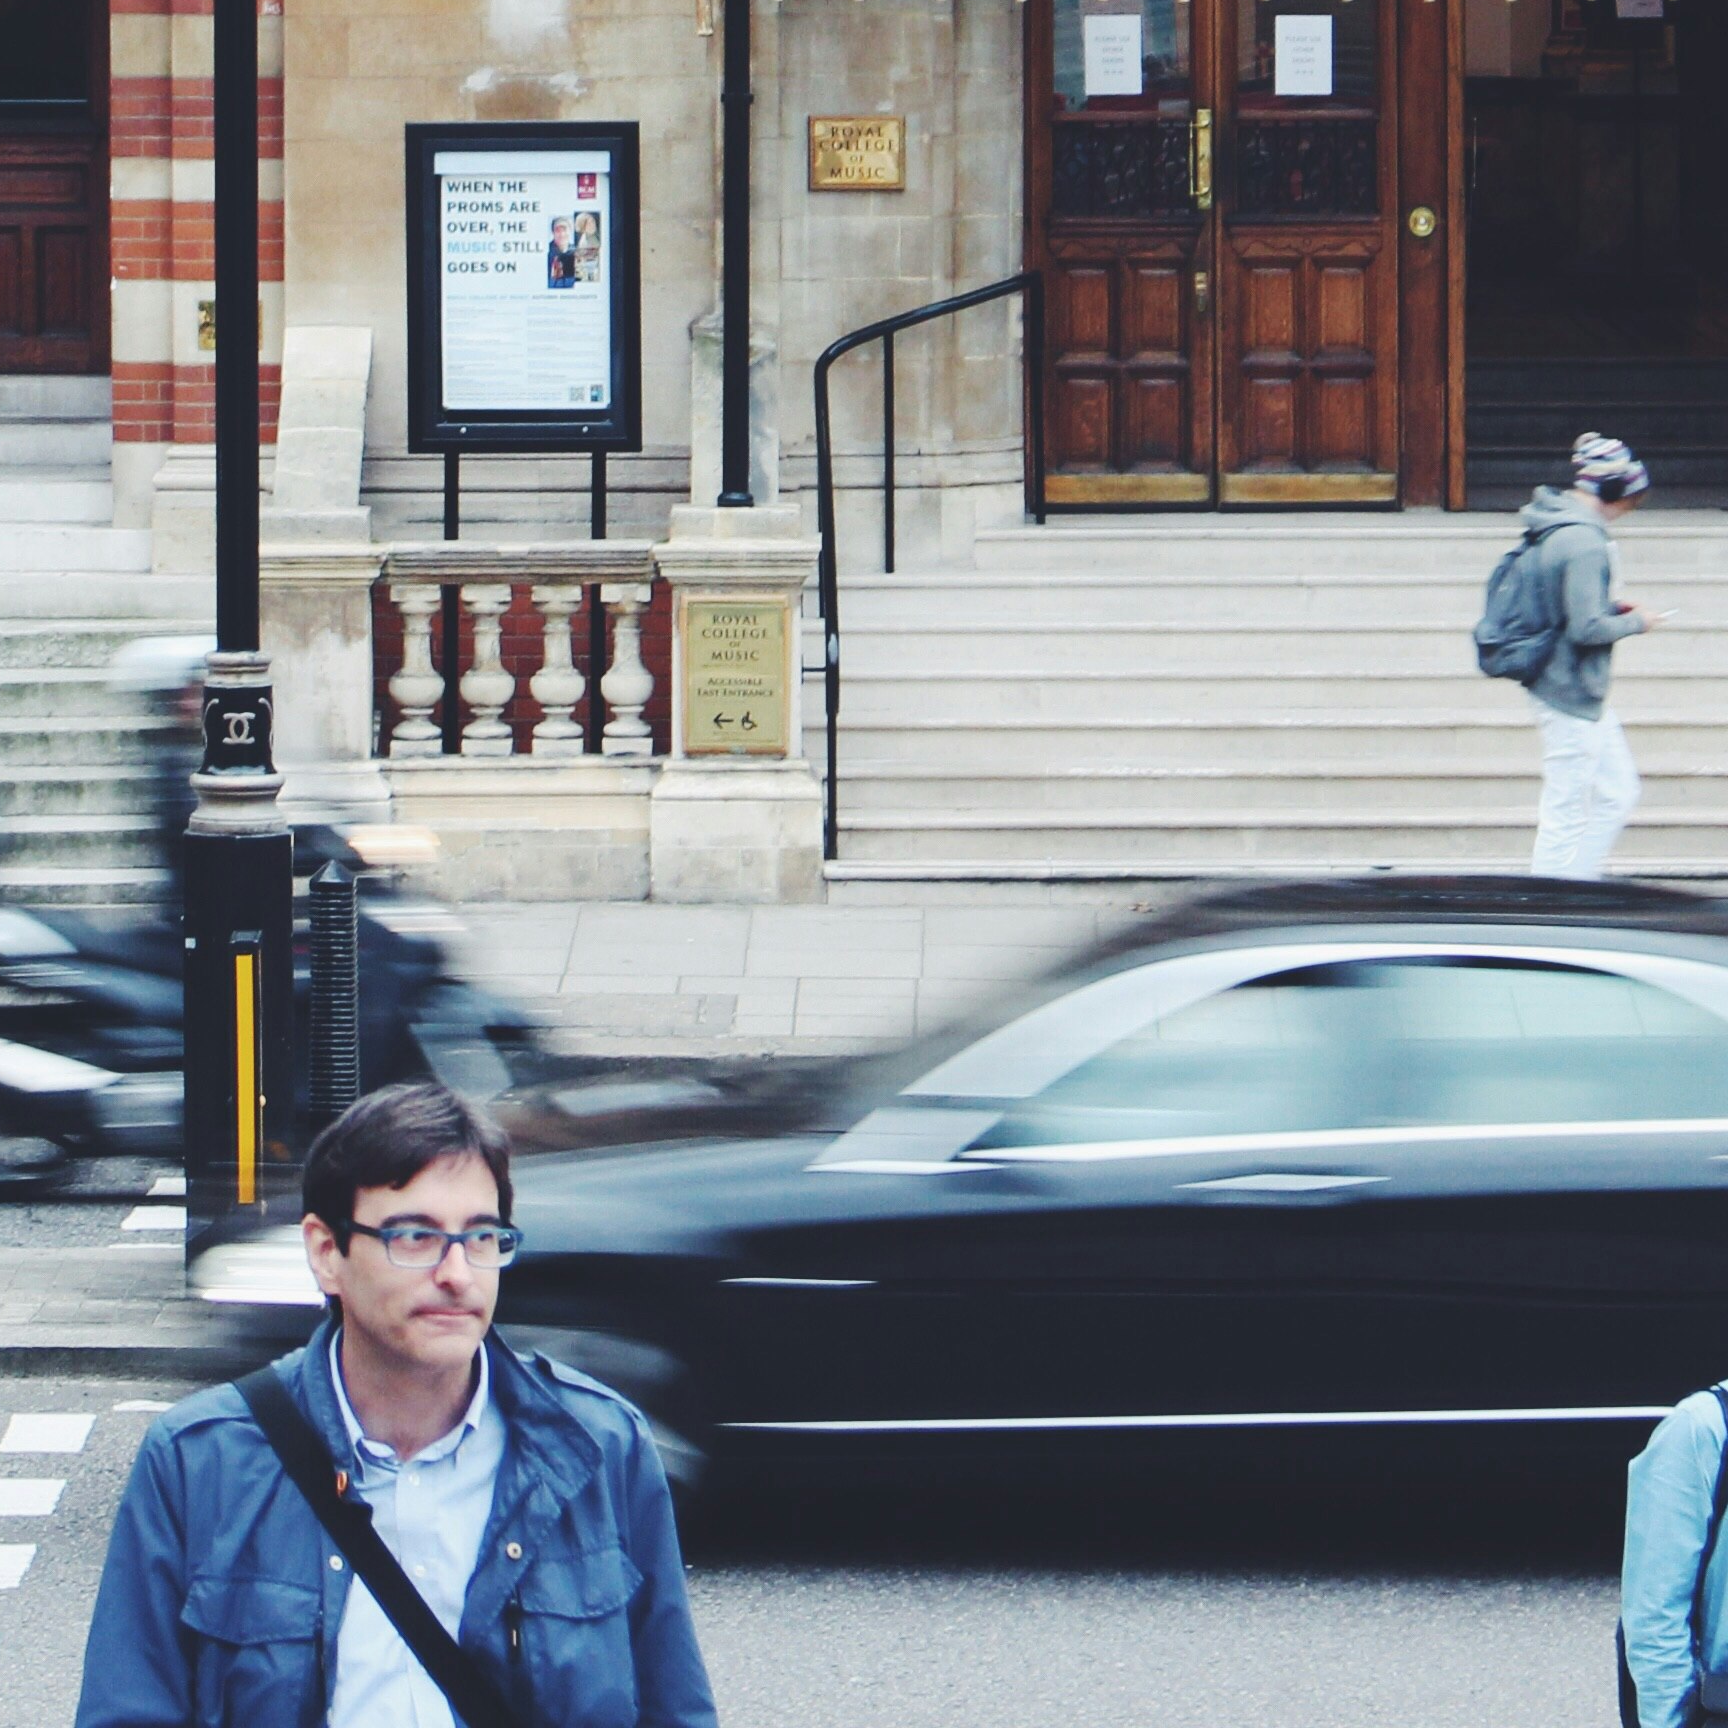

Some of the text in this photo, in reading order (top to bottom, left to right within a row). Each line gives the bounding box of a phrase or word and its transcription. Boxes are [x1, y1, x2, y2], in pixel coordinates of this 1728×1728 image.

[831, 126, 884, 138] ROYAL
[818, 139, 896, 152] COLLEGE
[849, 155, 865, 163] OF
[830, 167, 886, 179] MUSIC
[446, 181, 528, 194] WHEN THE
[446, 201, 541, 214] PROMS ARE
[446, 221, 528, 236] OVER, THE
[446, 241, 544, 254] MUSIC STILL
[446, 261, 517, 274] GOES ON
[712, 614, 760, 626] ROYAL
[702, 628, 768, 640] COLLEGE
[711, 649, 760, 662] MUSIC
